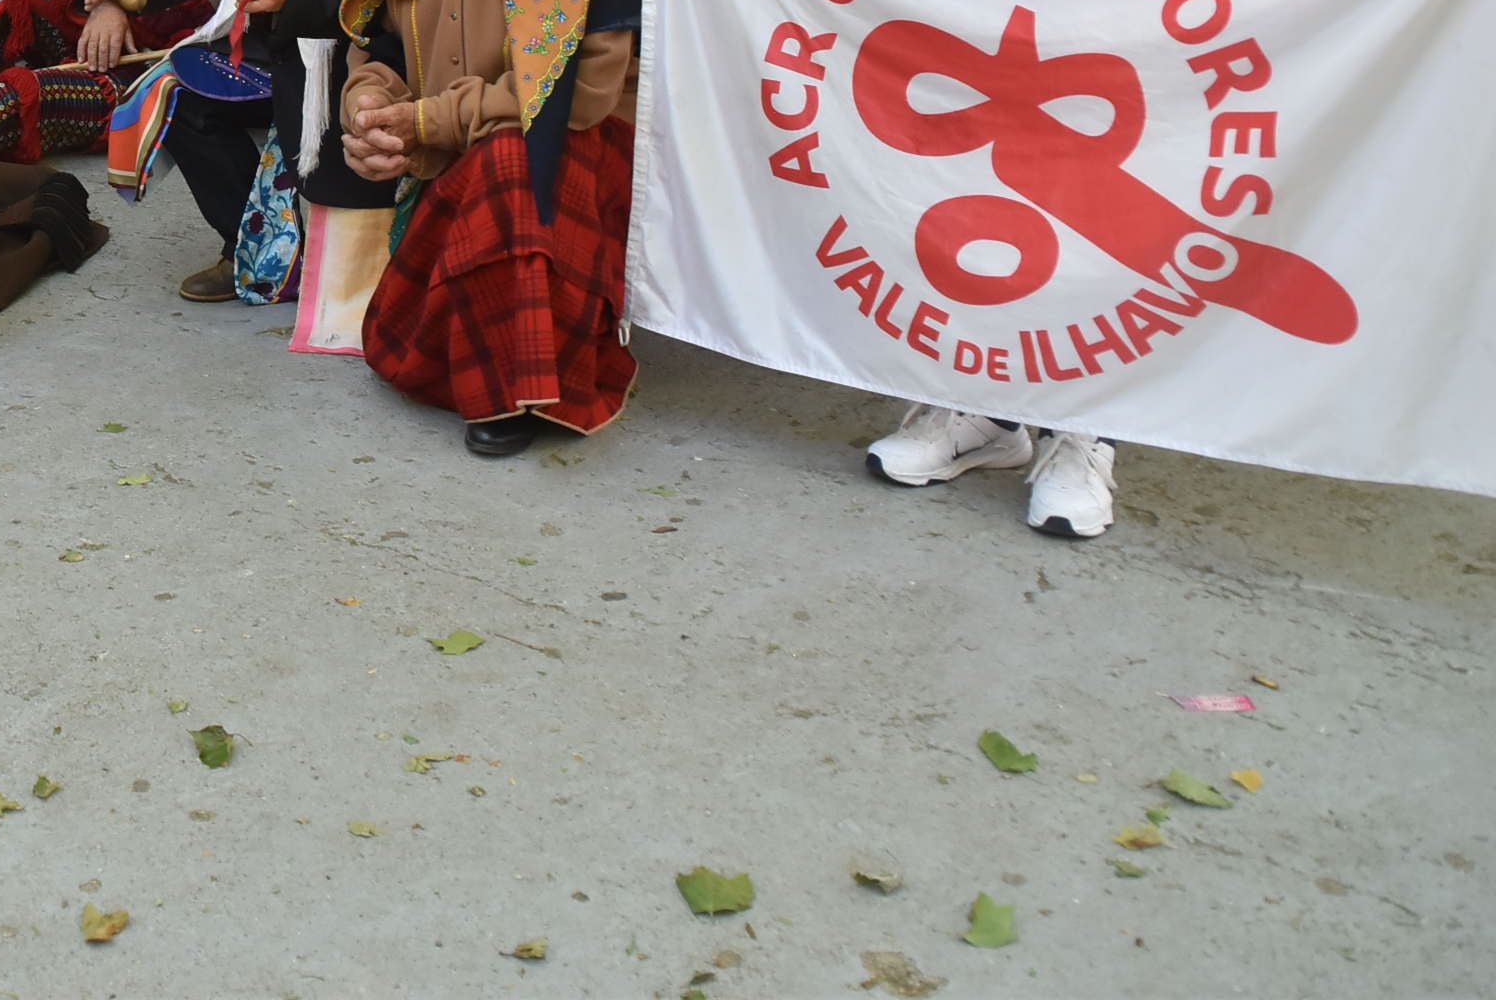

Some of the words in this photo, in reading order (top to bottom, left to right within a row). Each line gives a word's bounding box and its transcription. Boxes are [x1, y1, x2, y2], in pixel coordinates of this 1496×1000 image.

[761, 20, 839, 189] ACR
[815, 214, 950, 361] VALE
[953, 339, 1011, 382] DE
[1019, 231, 1240, 383] ILHAVO
